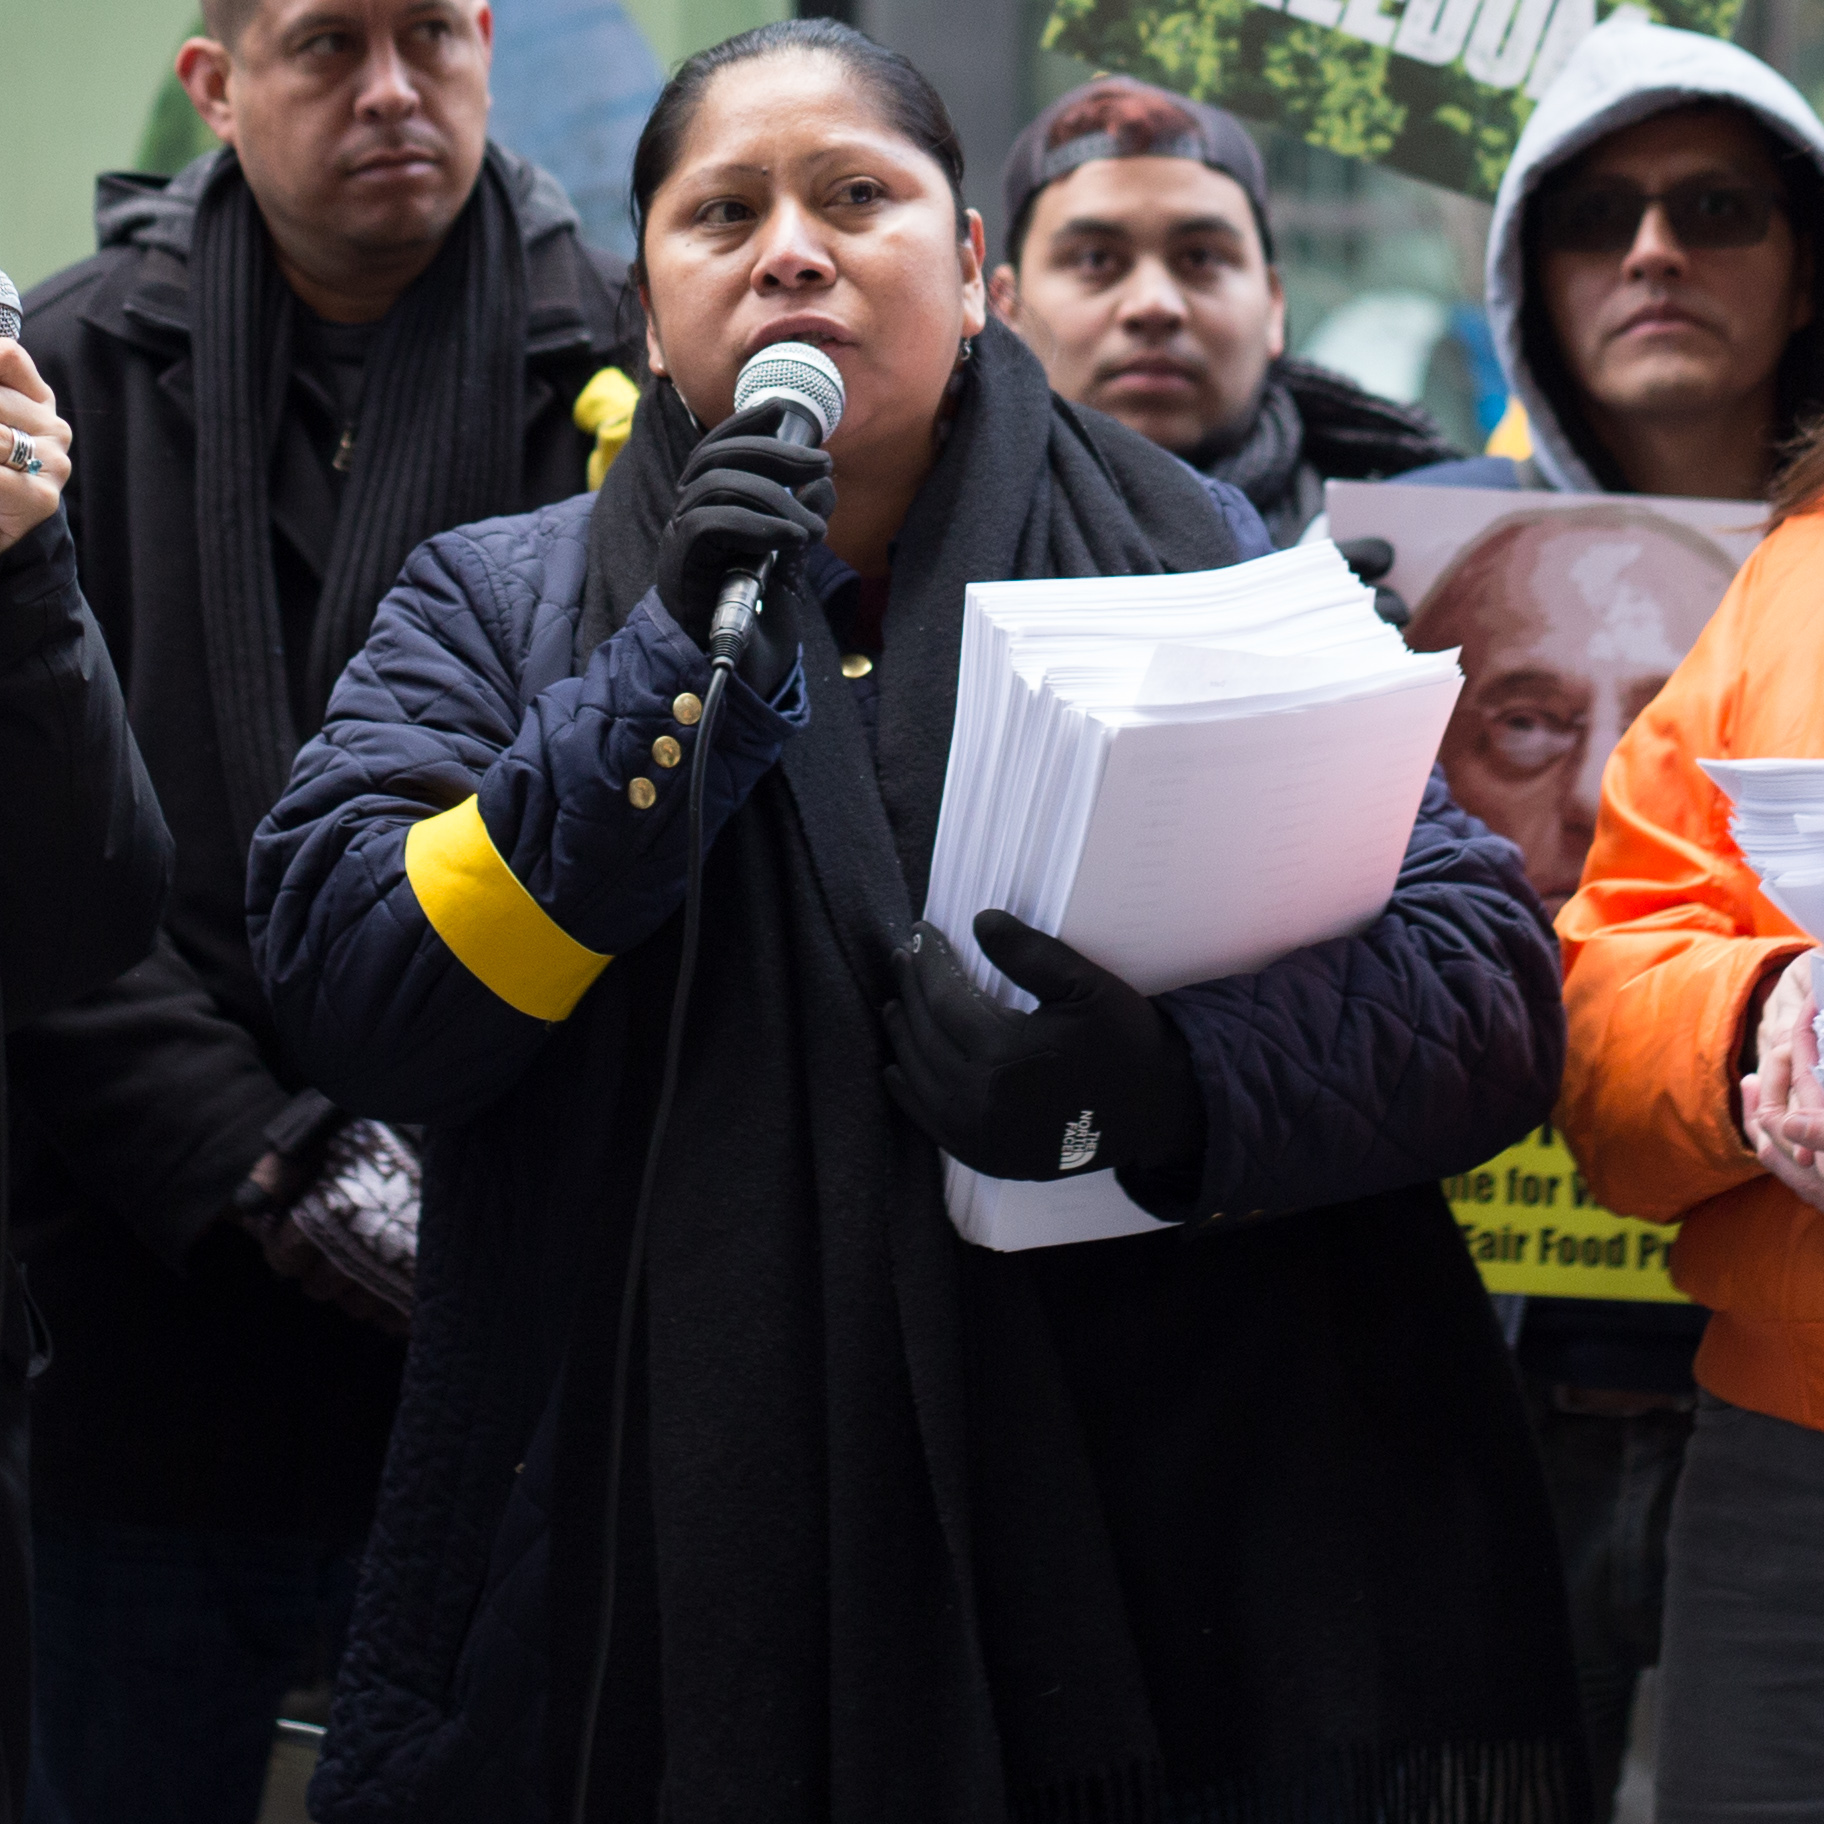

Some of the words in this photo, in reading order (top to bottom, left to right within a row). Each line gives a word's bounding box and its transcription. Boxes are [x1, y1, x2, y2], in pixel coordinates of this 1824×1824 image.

[1061, 1122, 1078, 1152] FACE
[1075, 1110, 1095, 1151] NORTH
[1086, 1131, 1102, 1150] THE
[1506, 1164, 1560, 1208] for
[1539, 1227, 1629, 1270] Food
